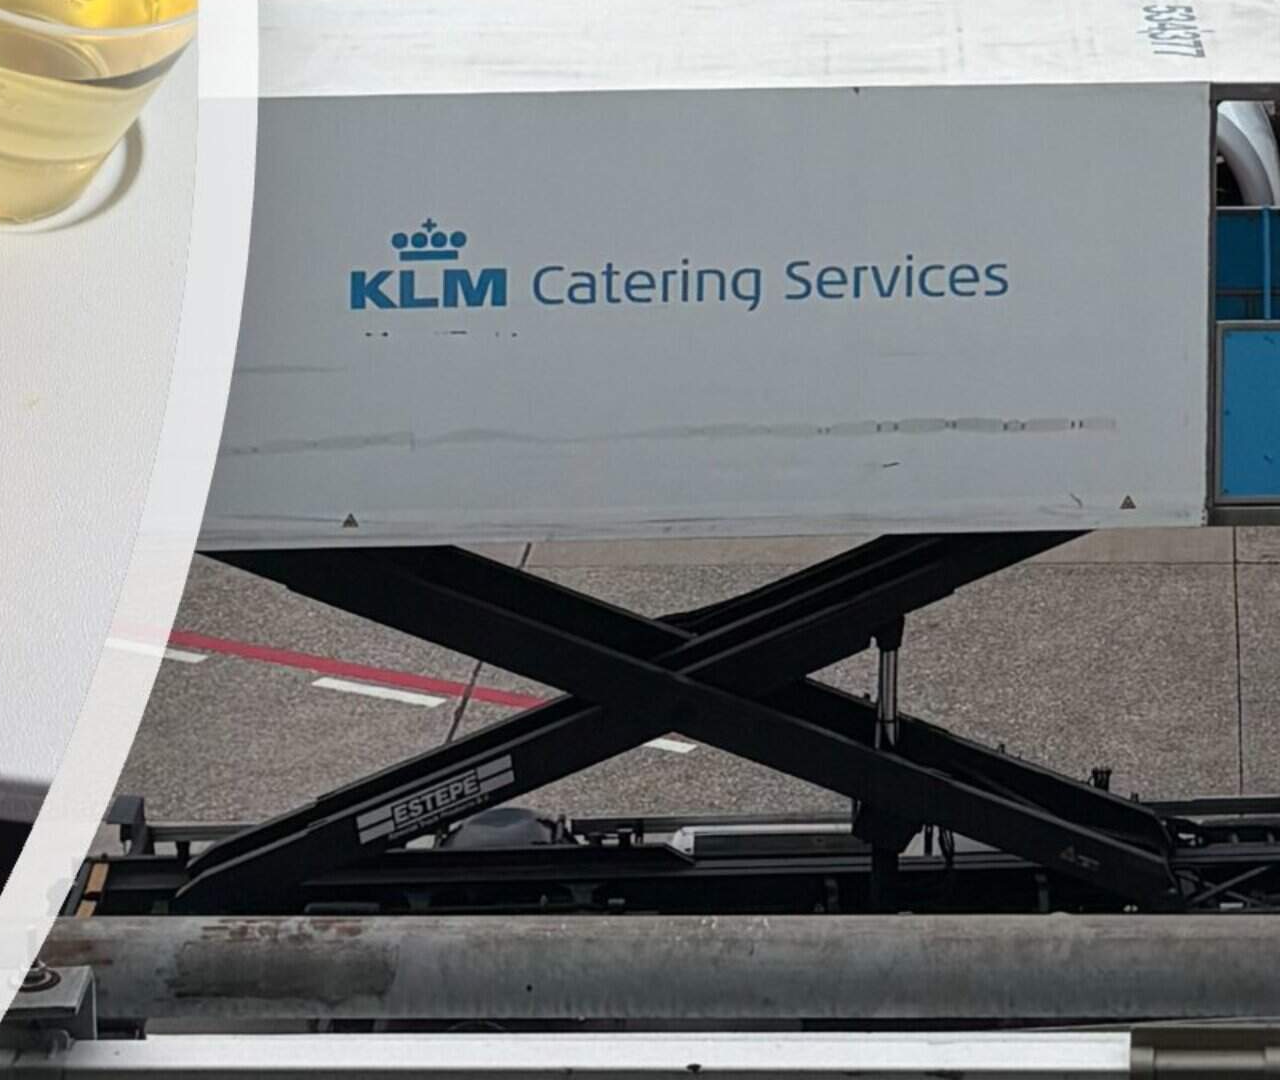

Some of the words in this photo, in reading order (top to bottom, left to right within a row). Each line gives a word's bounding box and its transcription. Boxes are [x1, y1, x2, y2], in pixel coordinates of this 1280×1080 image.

[349, 268, 508, 311] KLM
[531, 258, 763, 312] Catering
[784, 254, 1010, 301] Services
[392, 774, 480, 822] ESTEPE
